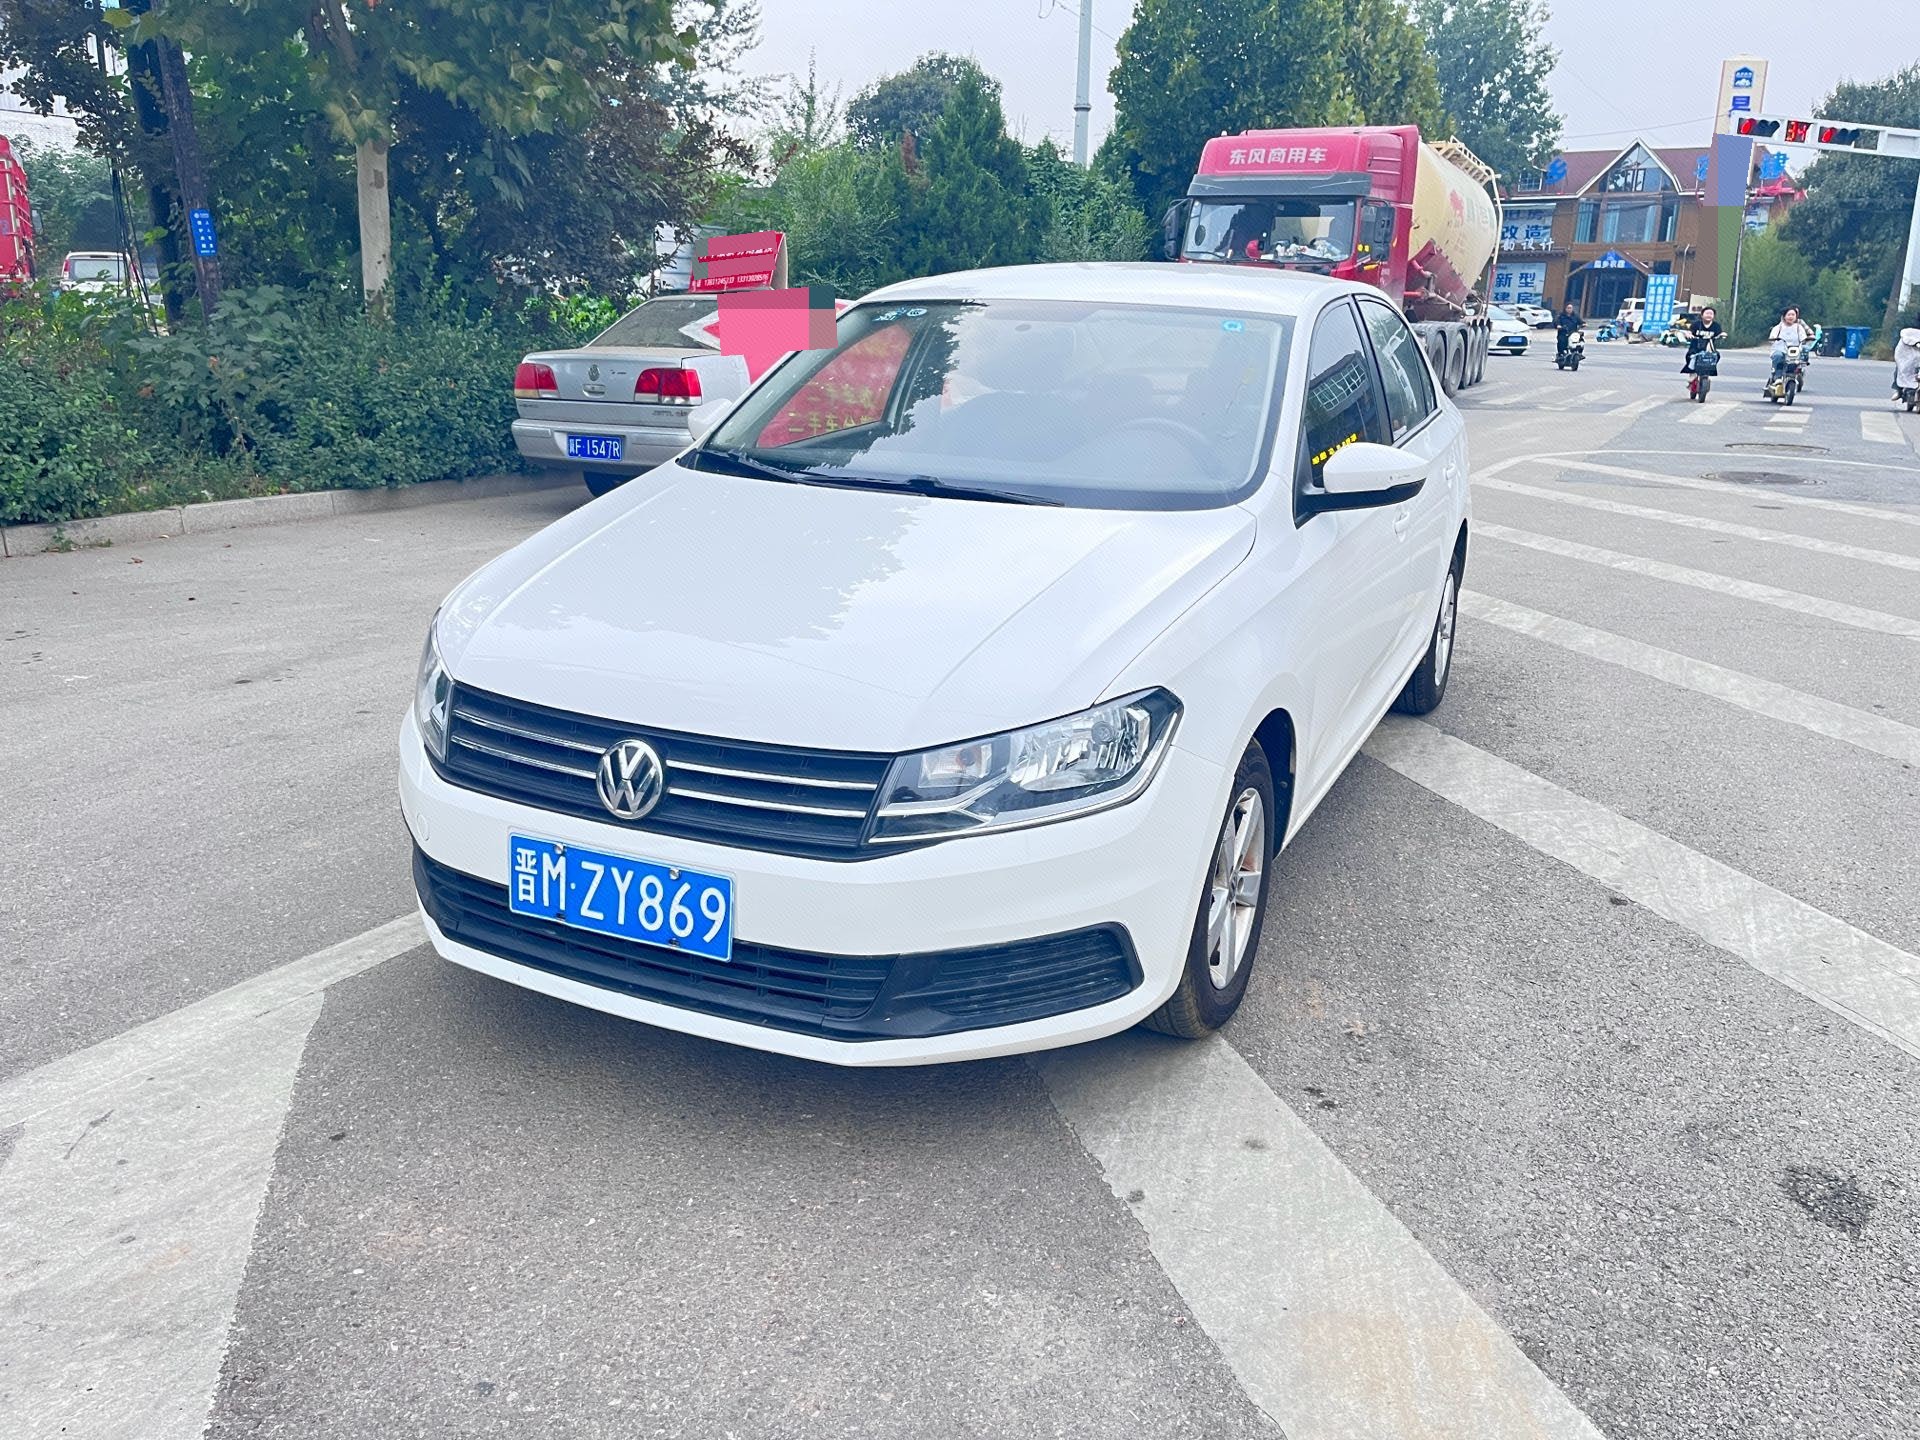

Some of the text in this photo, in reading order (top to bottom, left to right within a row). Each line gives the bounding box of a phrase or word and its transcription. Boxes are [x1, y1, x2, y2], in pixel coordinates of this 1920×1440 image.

[1229, 147, 1328, 165] 东风商用车
[1501, 225, 1544, 240] 改造
[1495, 272, 1536, 288] 新型
[514, 847, 727, 943] 晋M·ZY869
